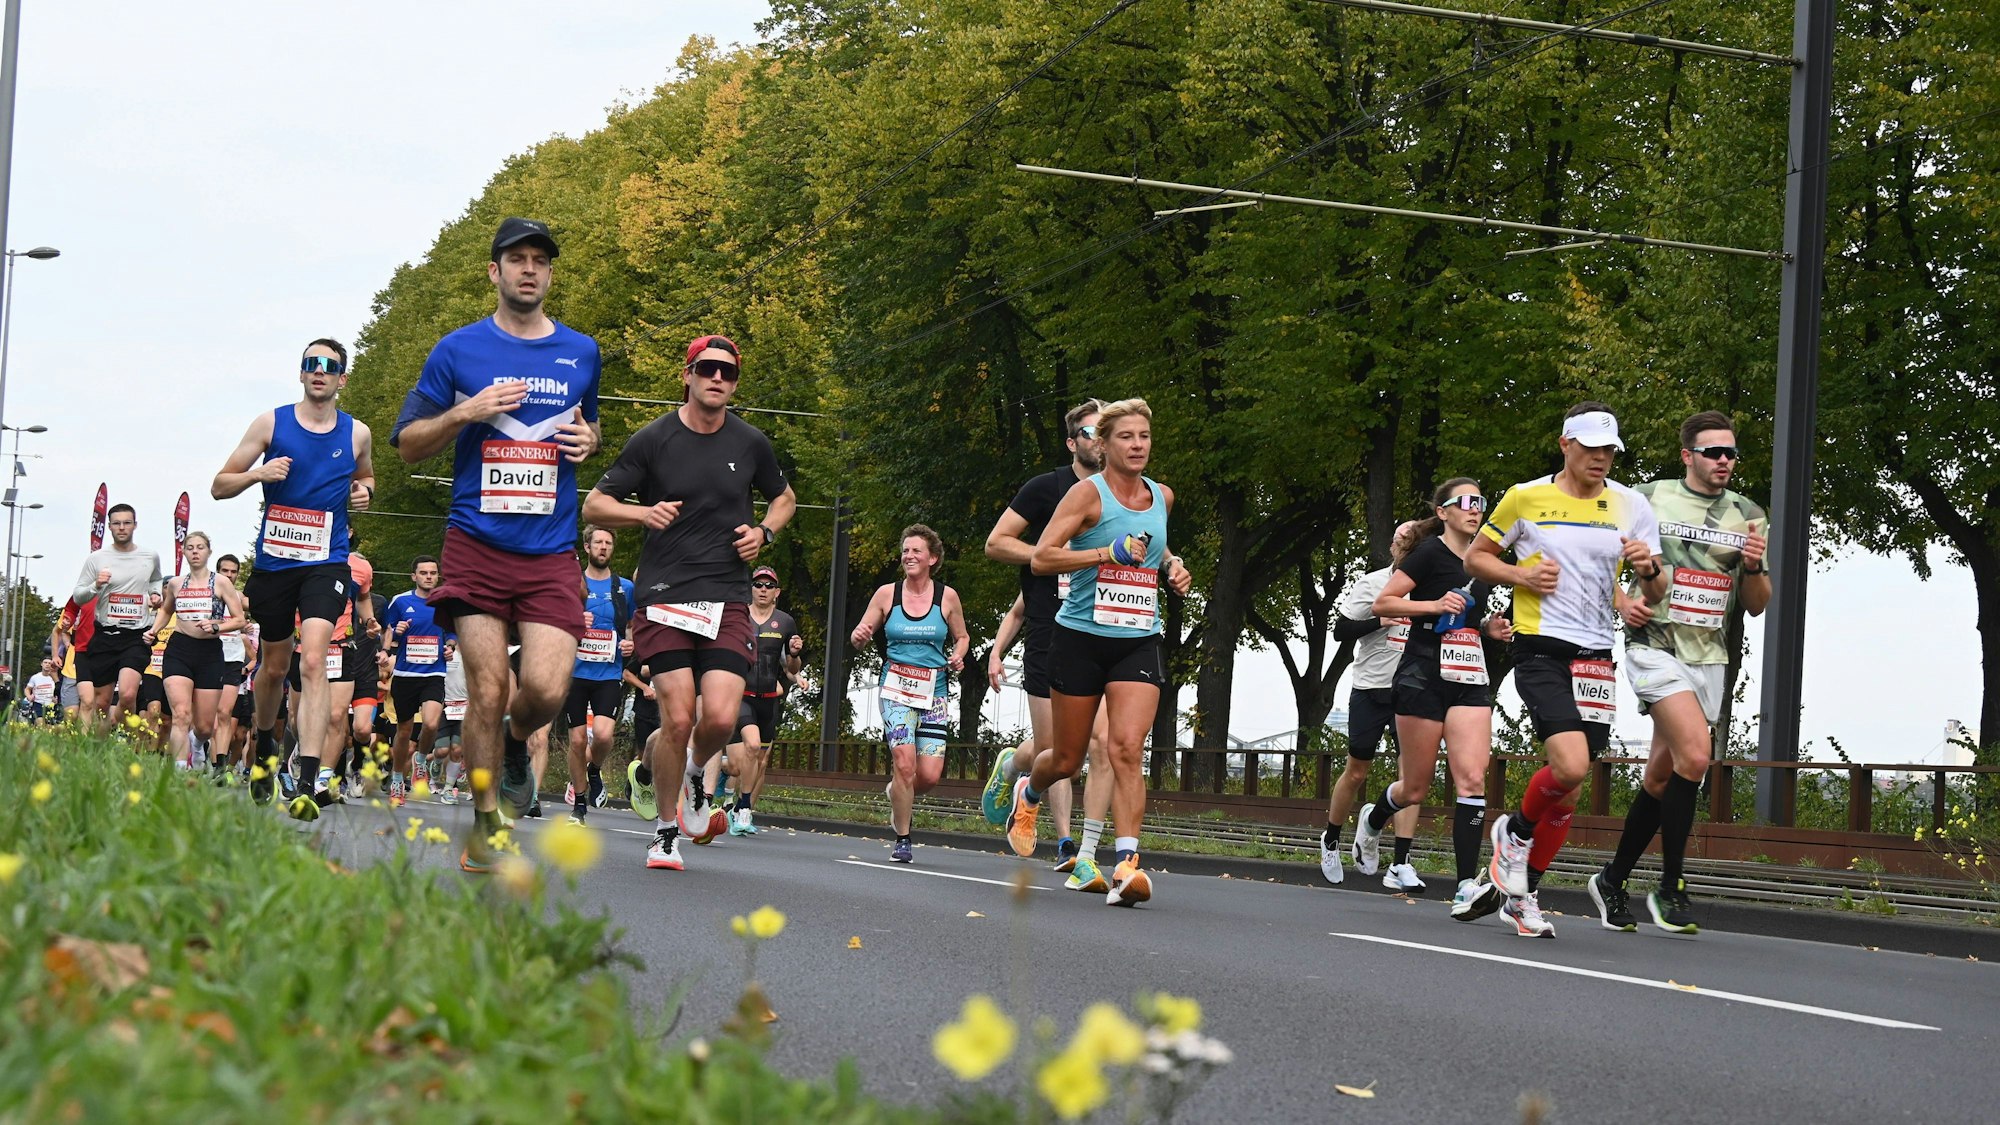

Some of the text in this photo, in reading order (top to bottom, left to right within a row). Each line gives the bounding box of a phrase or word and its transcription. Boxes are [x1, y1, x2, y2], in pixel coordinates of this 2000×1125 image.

[501, 446, 557, 460] GENERALI
[489, 468, 544, 486] David
[281, 511, 324, 525] GENERALI
[269, 525, 312, 542] Julian
[1660, 523, 1748, 549] SPORTKAMERAD
[1115, 570, 1157, 584] GENERALI
[1689, 575, 1731, 588] GENERALI
[1097, 587, 1151, 606] Yvonne
[1672, 589, 1694, 602] Erik
[1697, 594, 1722, 606] Sven
[110, 605, 138, 615] Niklas
[580, 642, 607, 651] regor
[899, 666, 930, 678] GENERALI
[897, 675, 919, 688] T544
[1577, 682, 1610, 700] Niels
